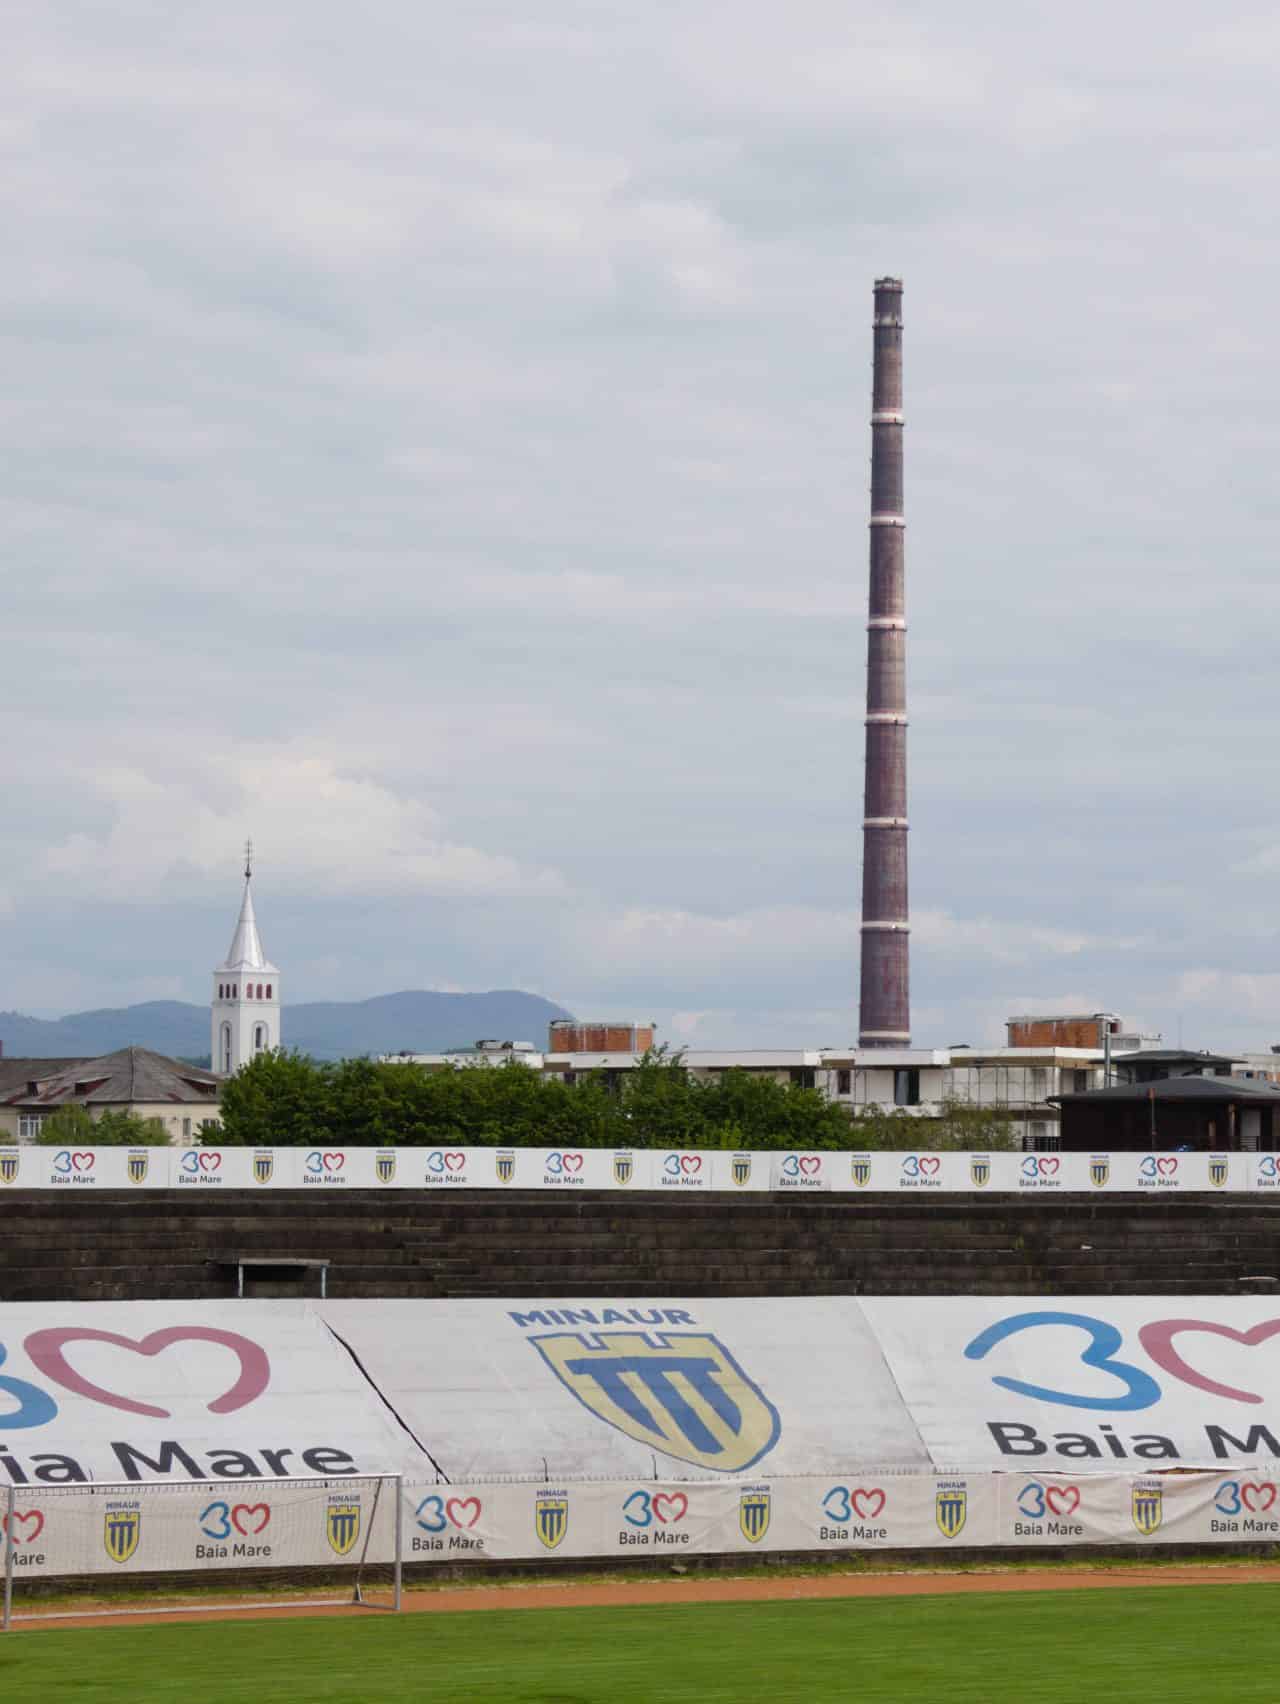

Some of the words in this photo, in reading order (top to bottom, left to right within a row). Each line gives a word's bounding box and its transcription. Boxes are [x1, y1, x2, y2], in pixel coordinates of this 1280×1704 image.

[50, 1175, 71, 1184] Baia
[72, 1175, 96, 1184] Mare
[178, 1174, 198, 1184] Baia
[199, 1175, 222, 1184] Mare
[303, 1174, 322, 1184] Baia
[323, 1175, 346, 1184] Mare
[424, 1174, 444, 1184] Baia
[444, 1174, 467, 1183] Mare
[543, 1175, 562, 1185] Baia
[563, 1175, 585, 1185] Mare
[661, 1176, 680, 1186] Baia
[680, 1177, 703, 1186] Mare
[778, 1177, 799, 1187] Baia
[799, 1177, 822, 1187] Mare
[899, 1177, 919, 1187] Baia
[919, 1178, 942, 1187] Mare
[1018, 1178, 1038, 1187] Baia
[1039, 1178, 1061, 1187] Mare
[1137, 1178, 1157, 1187] Baia
[1157, 1178, 1180, 1187] Mare
[1256, 1178, 1276, 1187] Baia
[507, 1309, 696, 1327] MINAUR
[986, 1422, 1181, 1458] Baia
[110, 1441, 359, 1481] Mare
[1014, 1522, 1043, 1536] Baia
[1047, 1521, 1084, 1536] Mare
[1210, 1519, 1239, 1533] Baia
[1242, 1519, 1278, 1533] Mare
[618, 1531, 649, 1545] Baia
[653, 1530, 690, 1545] Mare
[819, 1526, 849, 1541] Baia
[852, 1525, 888, 1540] Mare
[411, 1536, 444, 1551] Baia
[448, 1535, 485, 1551] Mare
[195, 1544, 228, 1559] Baia
[232, 1543, 272, 1557] Mare
